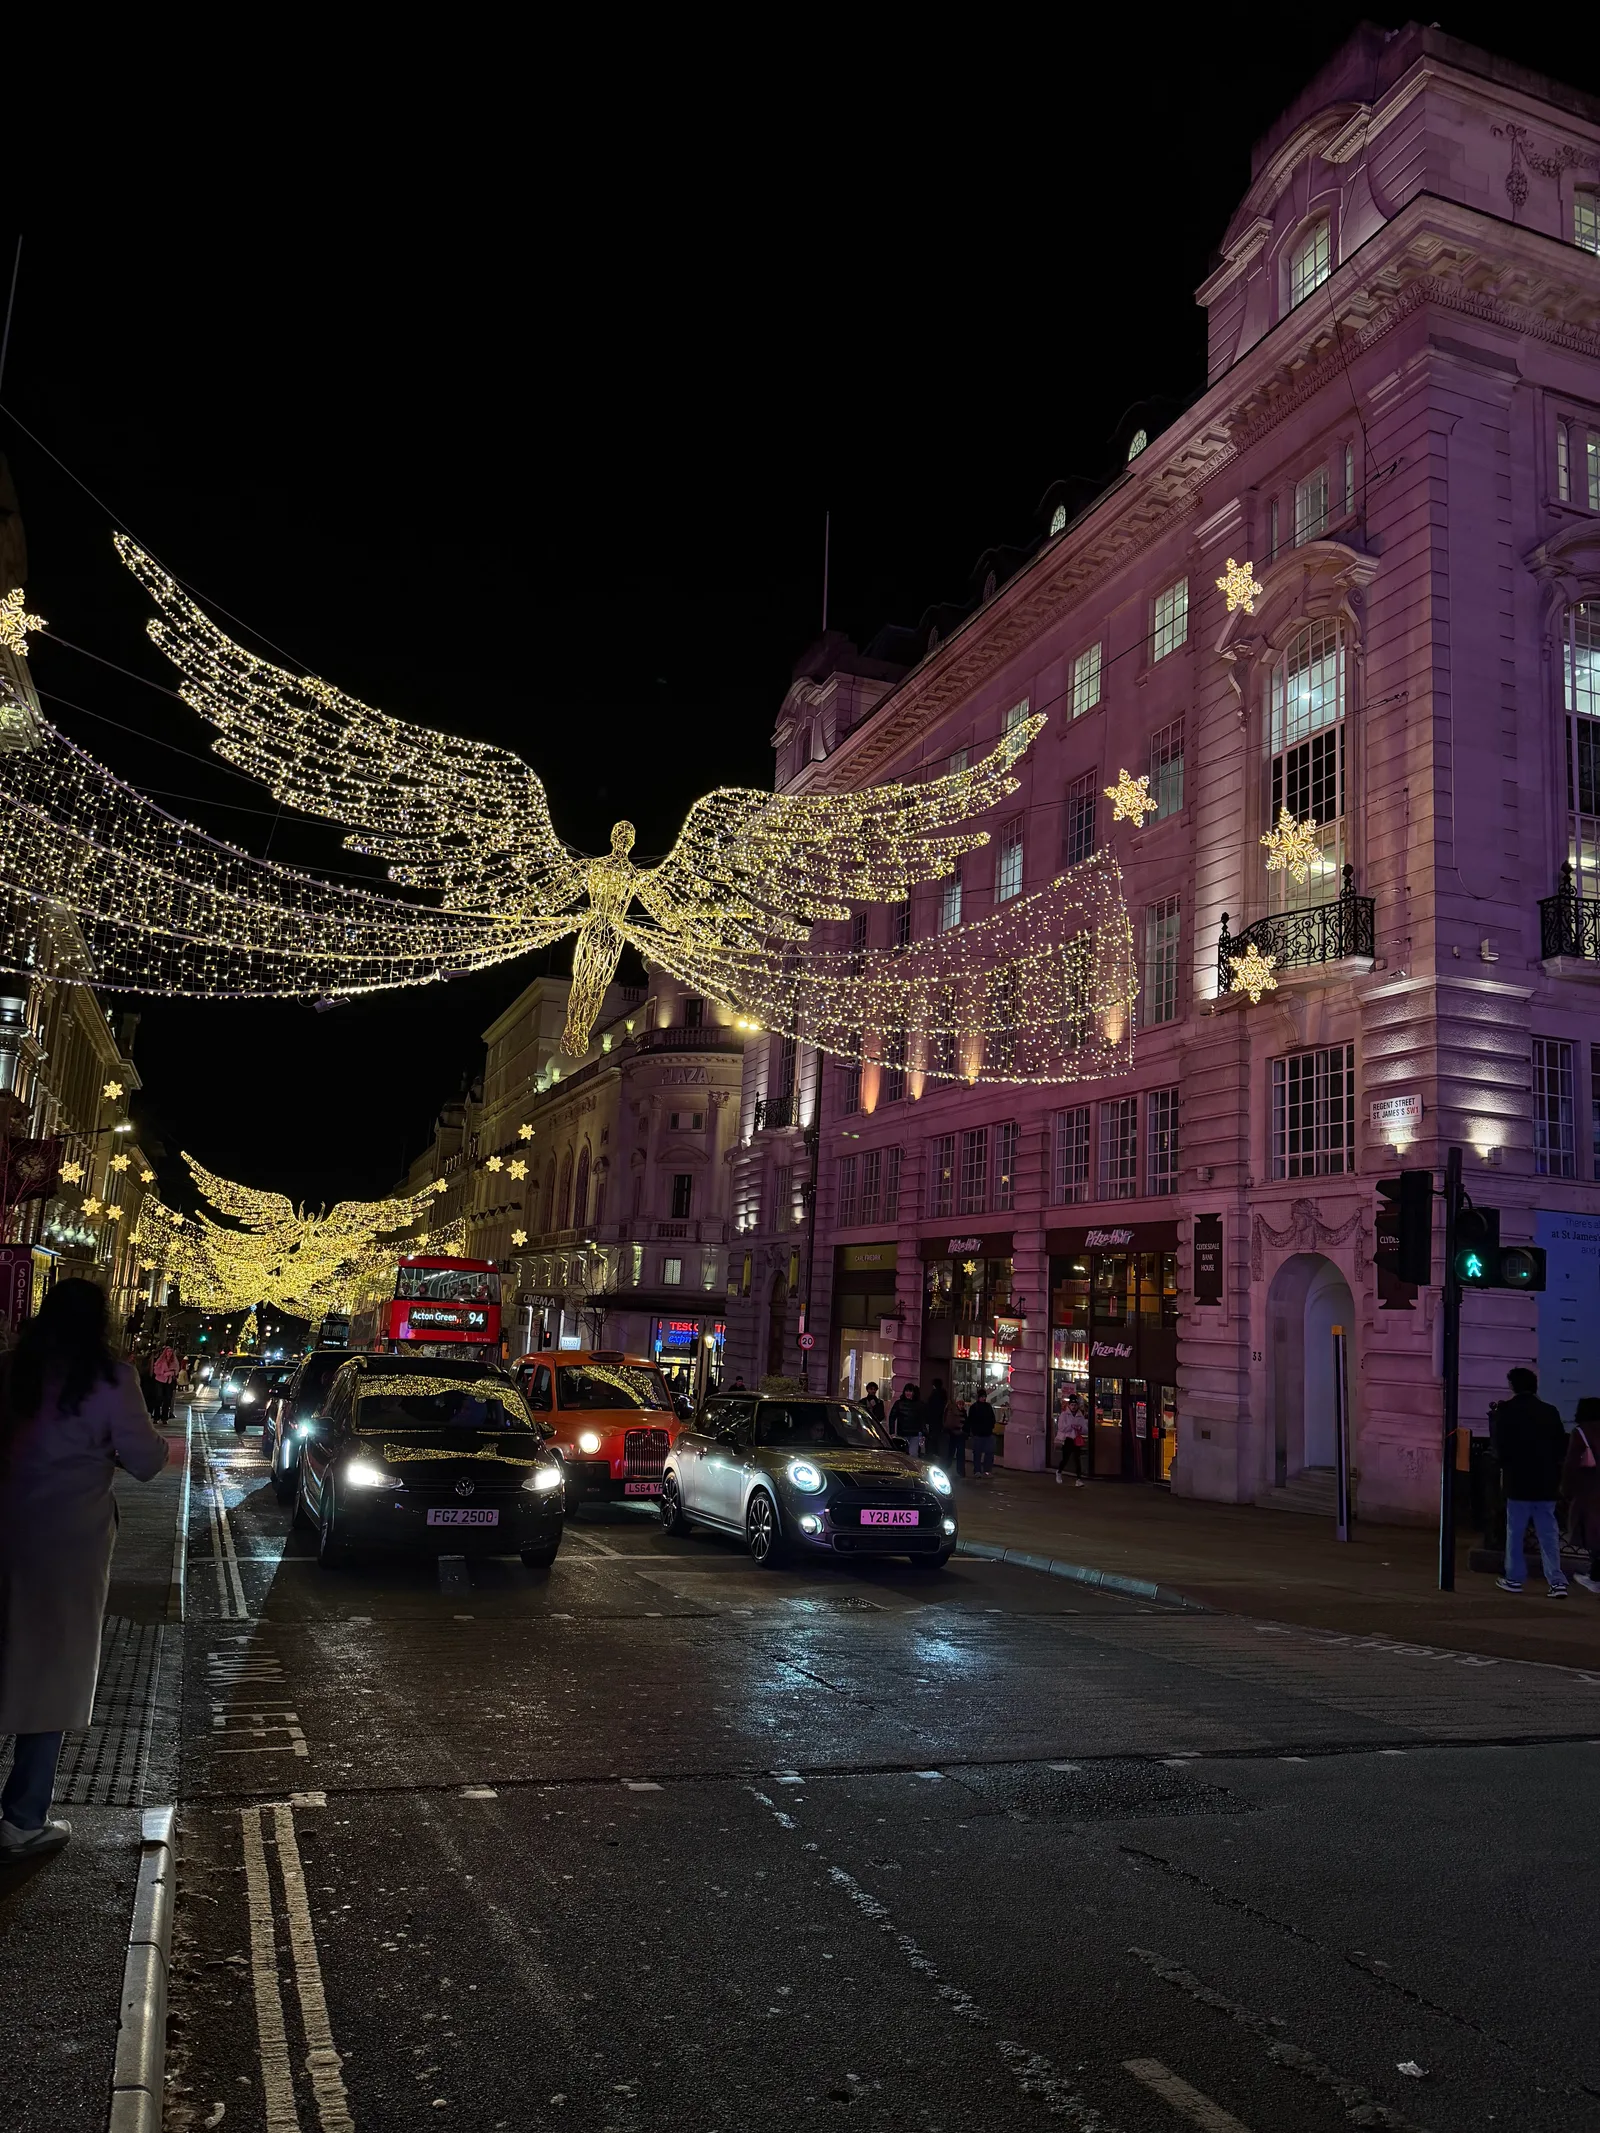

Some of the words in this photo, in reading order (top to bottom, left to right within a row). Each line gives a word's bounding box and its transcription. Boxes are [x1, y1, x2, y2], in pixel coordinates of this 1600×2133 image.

[661, 1067, 709, 1084] PLAZA
[1372, 1101, 1393, 1111] REGENT
[1394, 1097, 1416, 1108] STREET
[1372, 1111, 1381, 1120] ST.
[1406, 1106, 1419, 1115] SW1
[1565, 1217, 1592, 1229] There's
[1379, 1235, 1401, 1245] CLYDES
[1561, 1230, 1571, 1240] St
[1195, 1242, 1220, 1250] CLYDESDALE
[1201, 1253, 1214, 1261] BANK
[1200, 1264, 1215, 1272] HOUSE
[16, 1268, 26, 1309] SOFT
[523, 1293, 556, 1307] CINEMA
[412, 1311, 434, 1321] Acton
[435, 1312, 457, 1322] Green
[468, 1312, 484, 1325] 94
[998, 1324, 1019, 1334] Pizza
[802, 1337, 813, 1345] 20
[1000, 1333, 1016, 1341] Hut
[1091, 1341, 1114, 1357] Pizza
[1114, 1342, 1134, 1358] Hut
[1252, 1351, 1262, 1362] 33
[629, 1483, 651, 1493] LS64
[434, 1510, 459, 1523] FGZ
[461, 1510, 494, 1523] 2500
[869, 1511, 890, 1523] Y28
[892, 1512, 912, 1523] AKS
[204, 1651, 287, 1687] LOOK
[210, 1700, 309, 1757] LEFT
